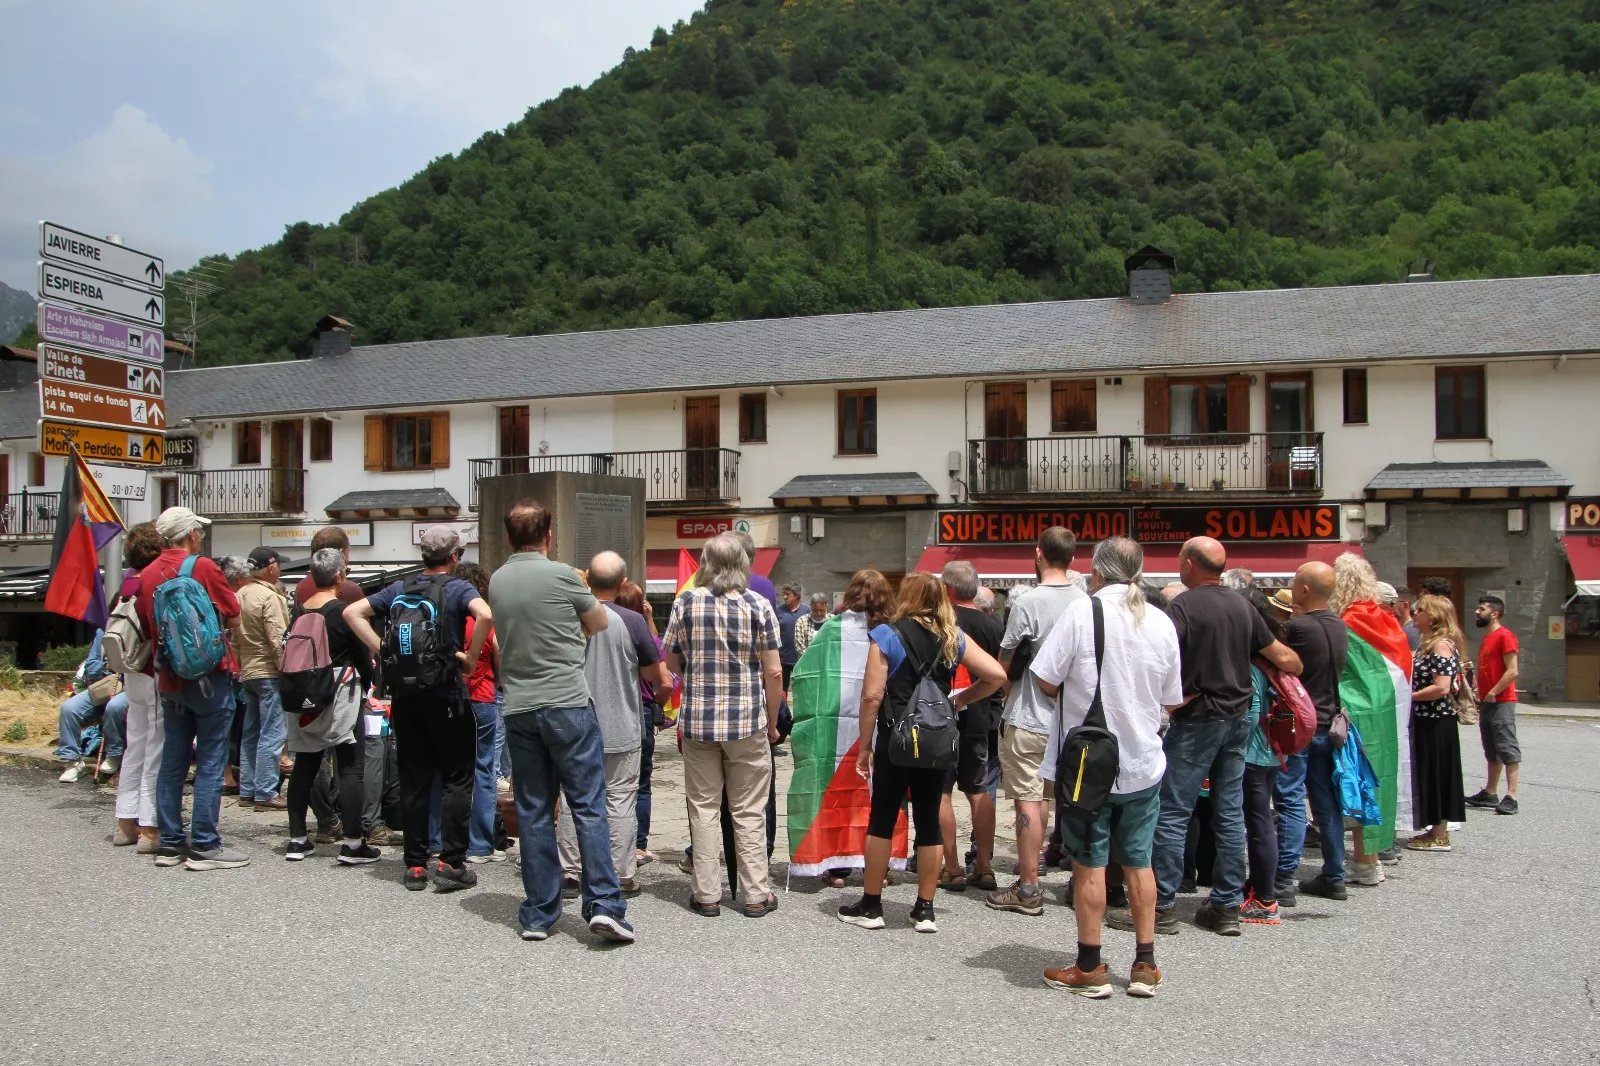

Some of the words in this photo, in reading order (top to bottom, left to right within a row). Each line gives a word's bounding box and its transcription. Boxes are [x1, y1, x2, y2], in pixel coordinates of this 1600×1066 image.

[47, 233, 101, 261] JAVIERRE
[46, 273, 103, 301] ESPIERBA
[47, 310, 62, 322] Arte
[64, 316, 68, 325] y
[70, 315, 105, 332] Naturaleza
[47, 323, 80, 338] Escultura
[98, 335, 127, 348] Armajani
[46, 349, 69, 362] Valle
[72, 355, 82, 364] de
[46, 361, 86, 380] Pineta
[44, 386, 66, 398] pista
[69, 391, 91, 402] esqui
[94, 394, 104, 404] de
[106, 395, 128, 407] fondo
[46, 400, 56, 410] 14
[60, 402, 74, 412] Km
[46, 437, 80, 452] Mone
[84, 441, 122, 456] Perdido
[164, 439, 193, 455] IONES
[94, 470, 102, 478] do
[112, 484, 144, 496] 30-07-25
[1138, 511, 1160, 520] CAVE
[1206, 508, 1333, 538] SOLANS
[682, 524, 728, 534] SPAR
[1138, 521, 1171, 530] FRUITS
[1138, 532, 1192, 541] SOUVENIRS
[402, 623, 410, 654] MUNICH
